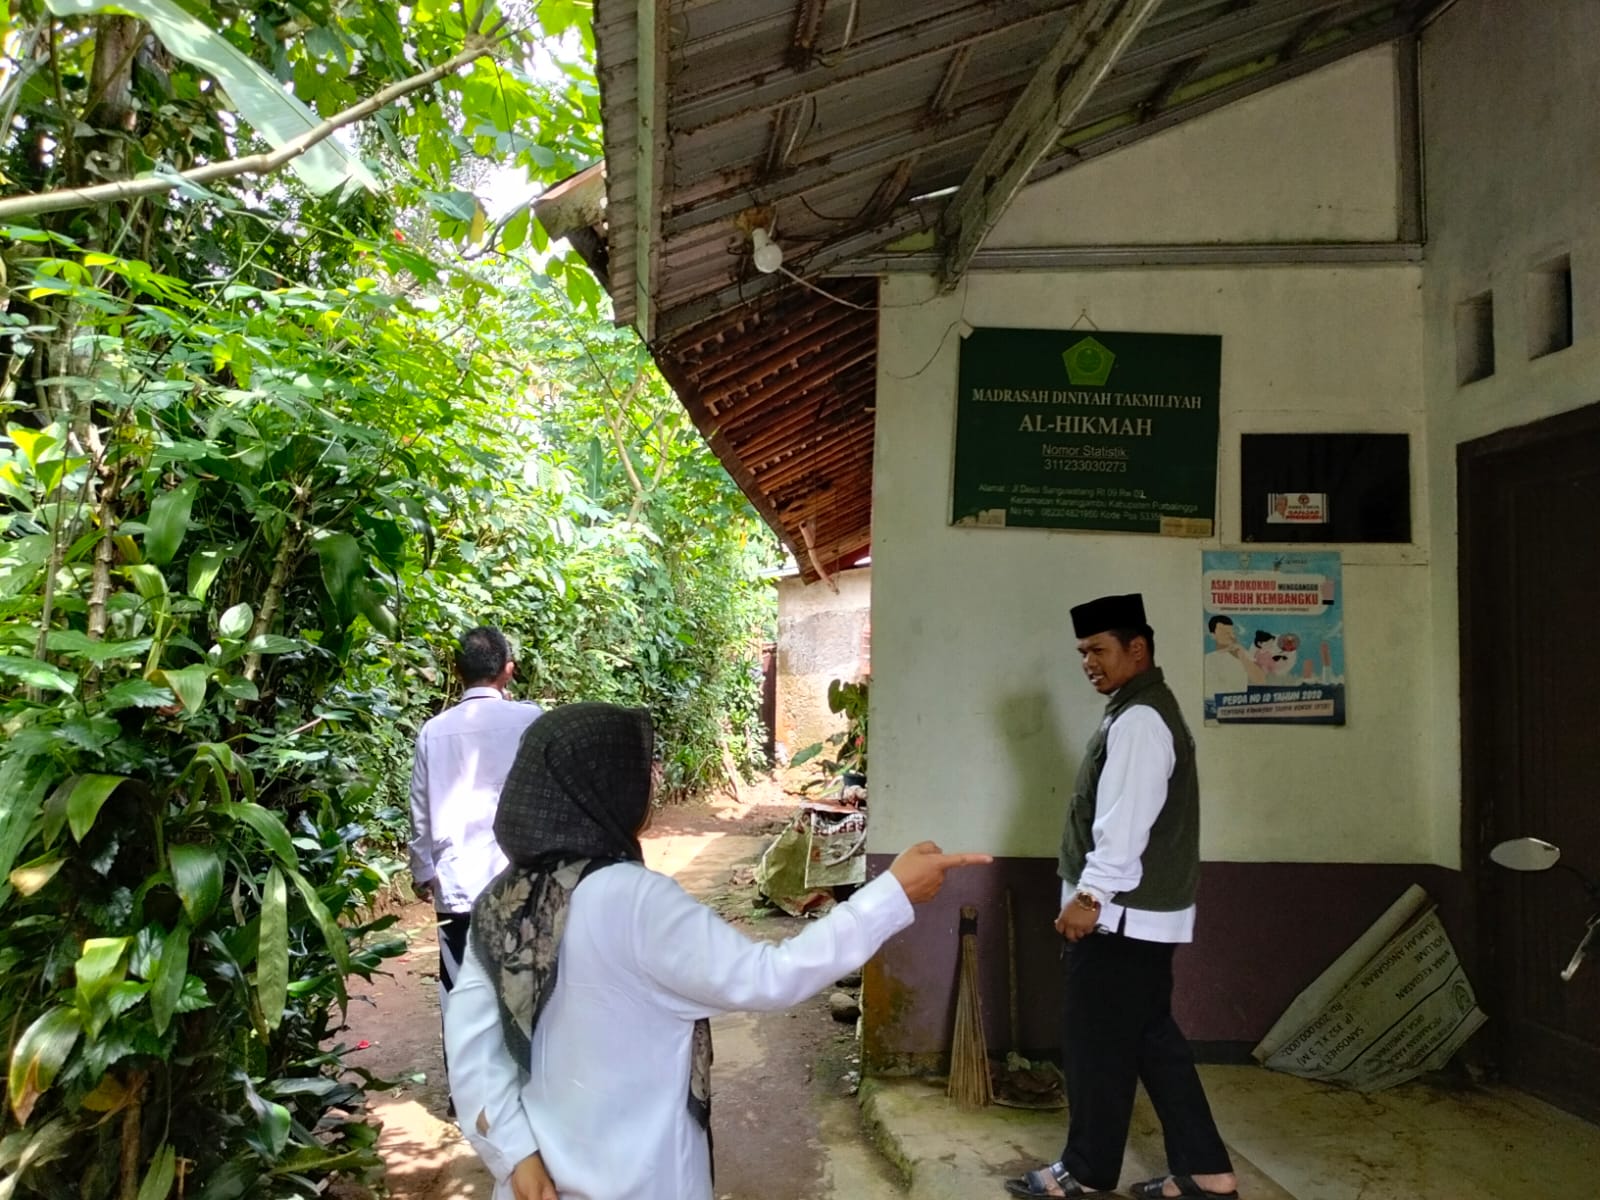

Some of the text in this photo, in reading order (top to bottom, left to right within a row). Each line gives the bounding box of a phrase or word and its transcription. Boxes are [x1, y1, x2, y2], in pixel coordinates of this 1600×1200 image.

[972, 388, 1202, 409] MADRASAH DINIYAH TAKMILIYAH
[1018, 414, 1153, 436] AL-HIKMAH
[1042, 444, 1127, 458] Nomor Statistik
[1044, 458, 1127, 473] 311233030273
[1211, 580, 1232, 590] ASAP
[1211, 592, 1318, 605] TUMBUH KEMBANGKU
[1360, 948, 1406, 989] ANGGARAN
